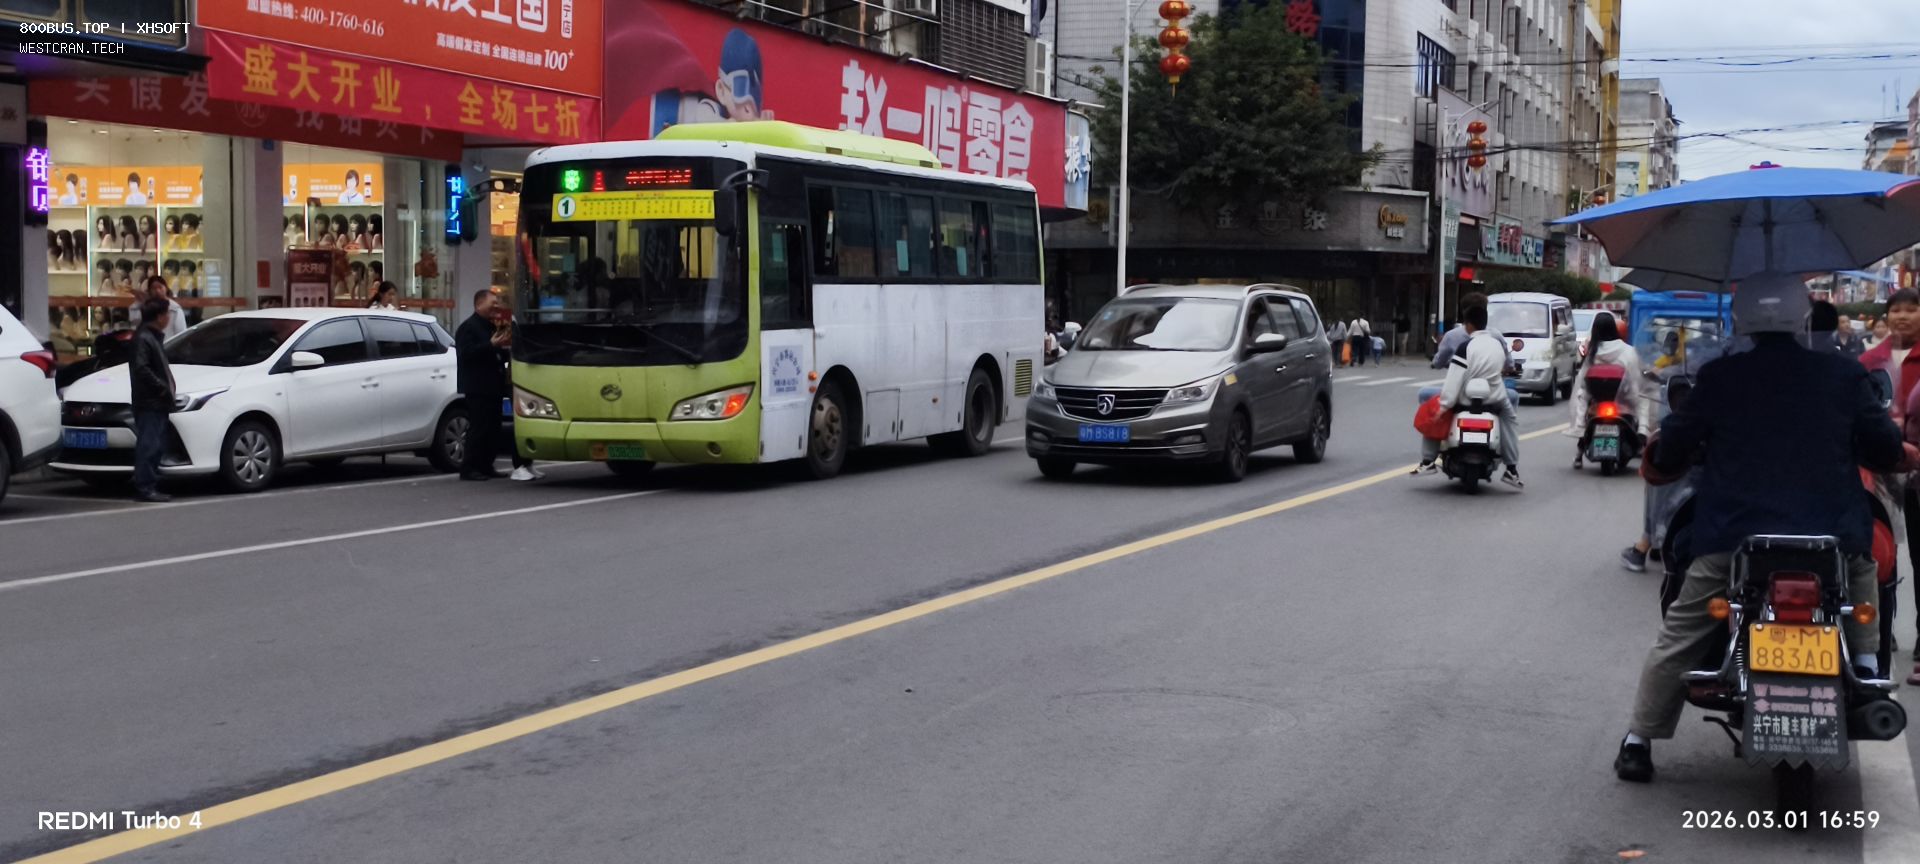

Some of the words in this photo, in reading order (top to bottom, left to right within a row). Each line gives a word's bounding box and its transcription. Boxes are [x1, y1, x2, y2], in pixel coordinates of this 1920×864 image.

[301, 6, 385, 37] 400-1760-616
[457, 80, 580, 139] 全场七折
[838, 59, 1034, 182] 赵一鸣零食
[562, 200, 570, 215] 1
[1756, 647, 1834, 673] 883A0
